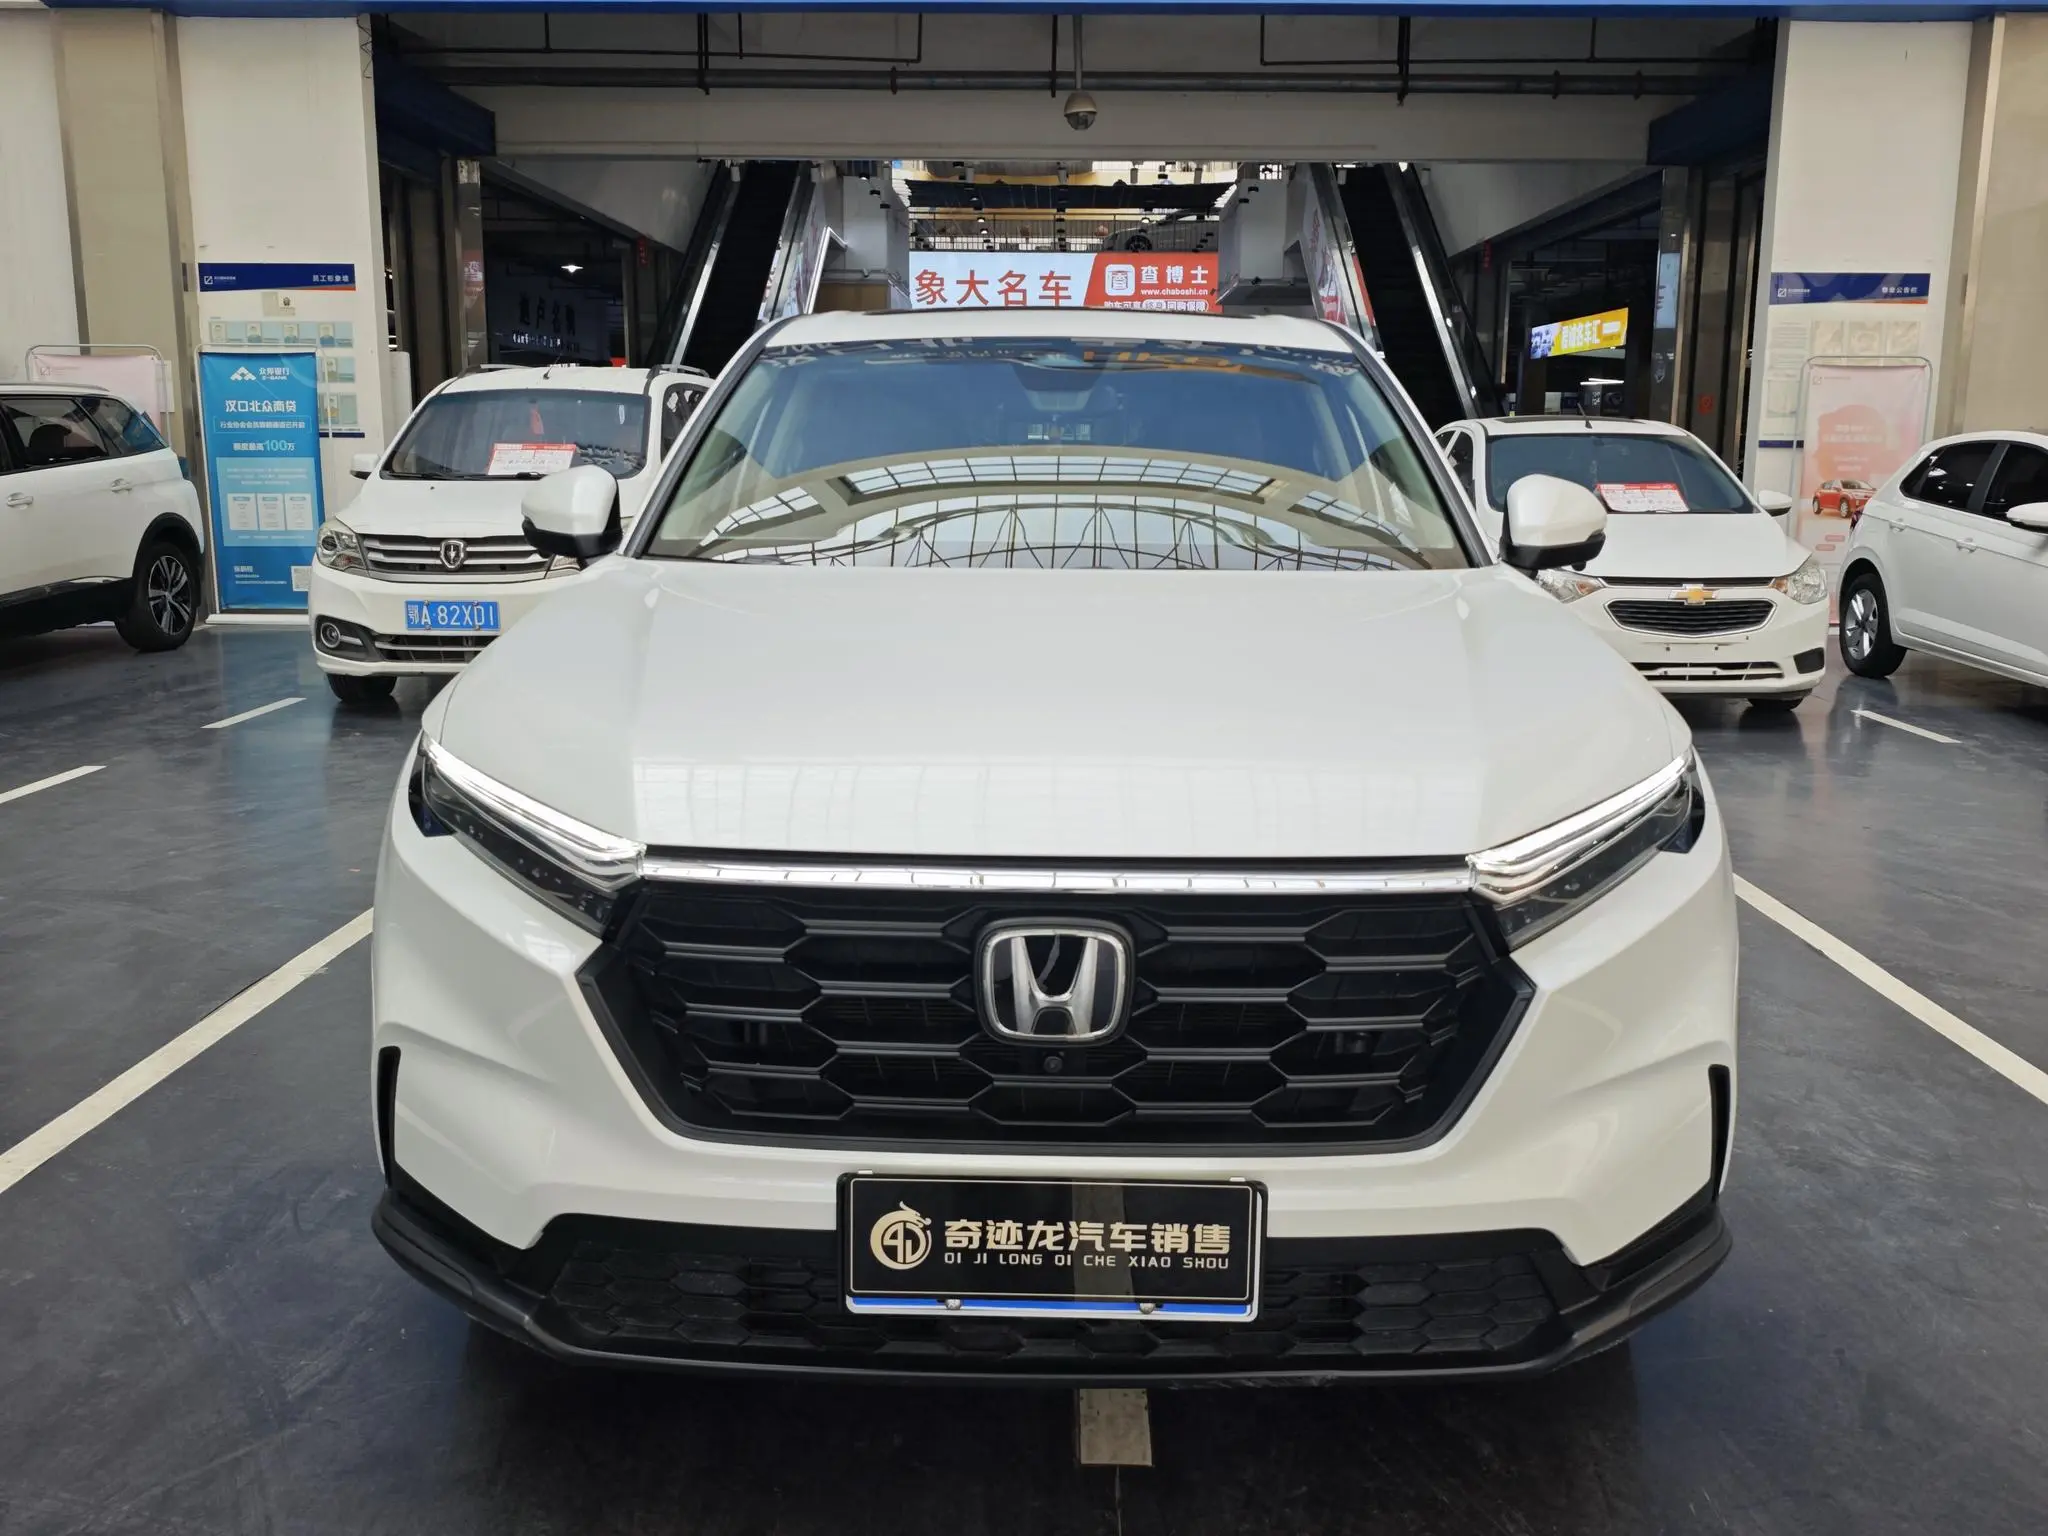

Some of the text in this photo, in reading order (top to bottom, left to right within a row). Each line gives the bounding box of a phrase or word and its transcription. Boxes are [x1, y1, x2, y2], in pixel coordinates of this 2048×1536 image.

[1141, 266, 1208, 284] 查博士
[915, 269, 1072, 307] 象大名车
[1141, 287, 1208, 296] www.chaboshi.cn
[225, 400, 297, 413] 汉口北众商贷
[944, 1219, 1232, 1255] 奇迹龙汽车销售
[973, 1252, 987, 1264] JI
[999, 1253, 1043, 1265] LONG
[1083, 1255, 1116, 1267] CHE
[1128, 1256, 1171, 1268] XIAO
[1183, 1257, 1229, 1269] SHOU
